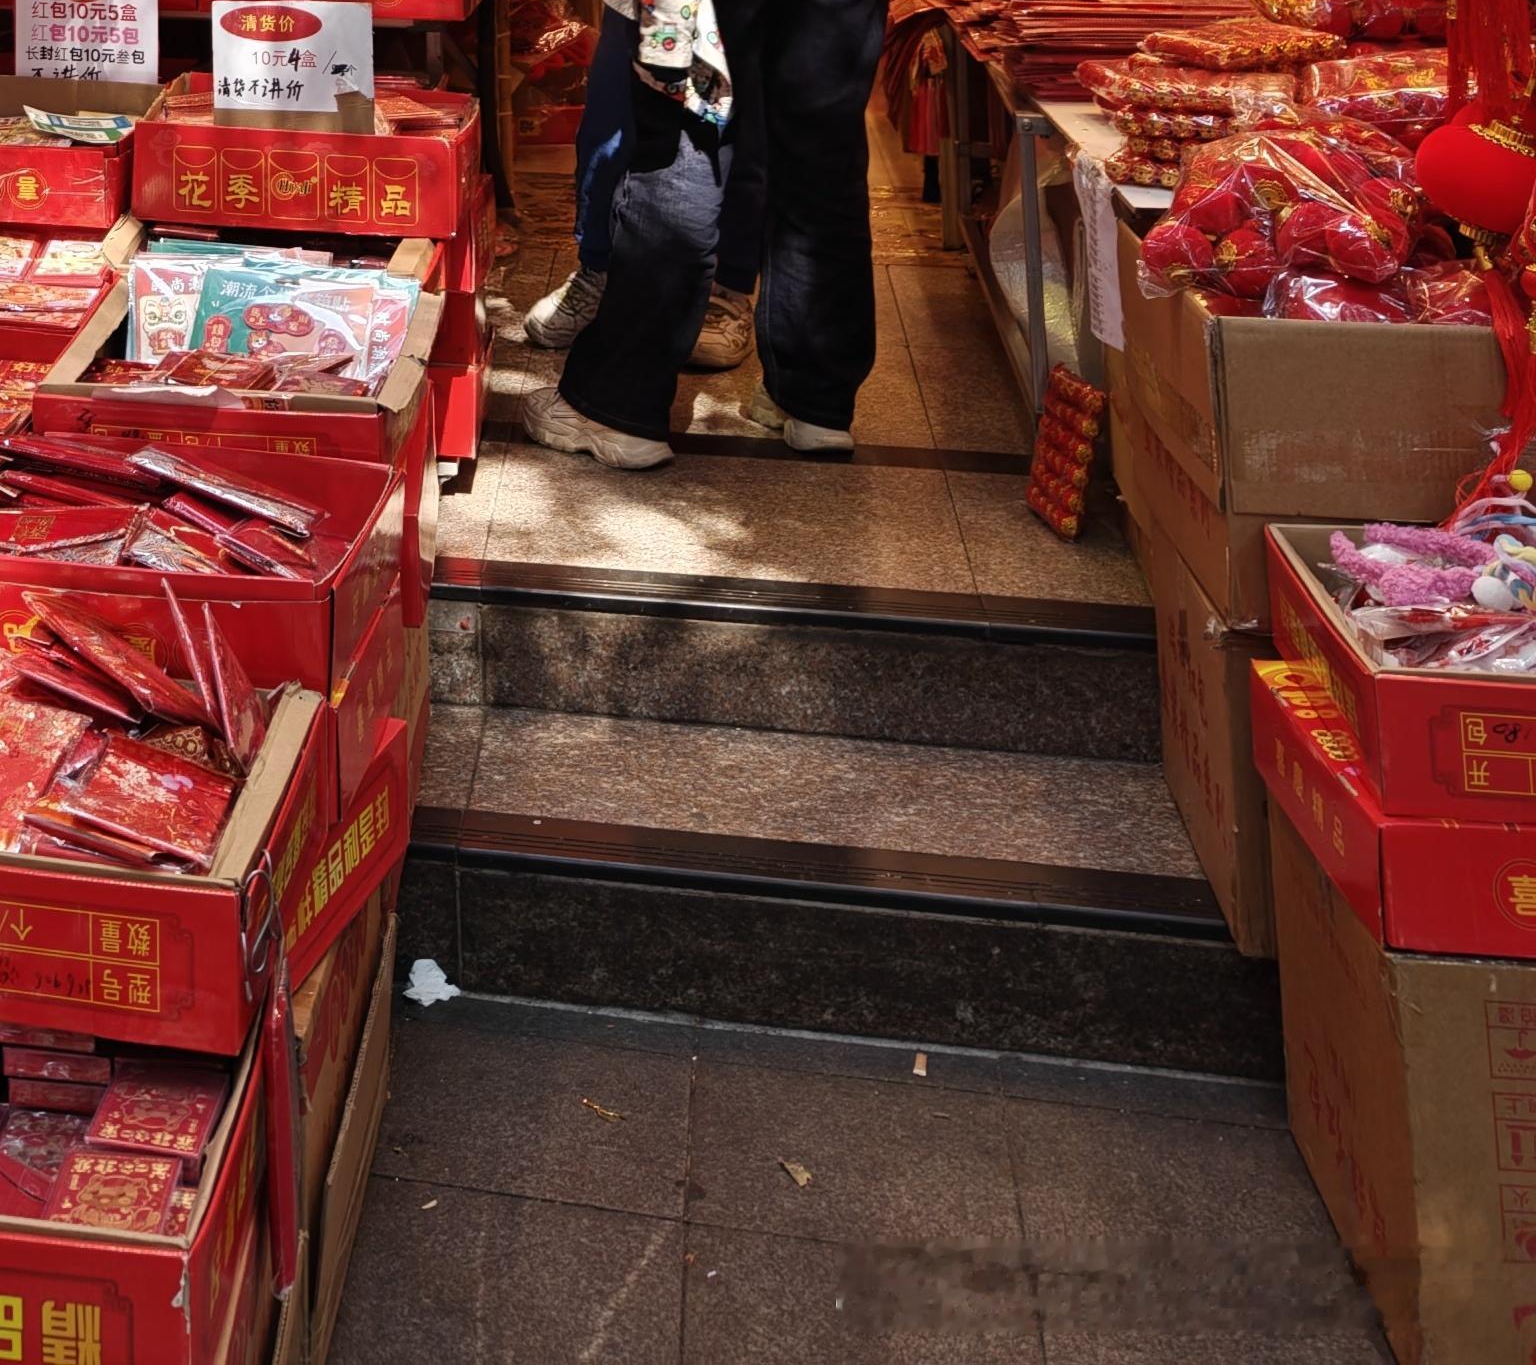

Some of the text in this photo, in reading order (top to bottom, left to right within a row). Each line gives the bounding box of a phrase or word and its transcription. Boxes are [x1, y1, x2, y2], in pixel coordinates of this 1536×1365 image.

[31, 0, 138, 23] 红包10元5盒
[239, 13, 296, 33] 清货价
[31, 23, 140, 45] 红包10元5包
[24, 45, 146, 65] 长封红包10元叁包
[251, 47, 318, 72] 10元4盒
[217, 75, 305, 102] 清货不讲价
[176, 168, 263, 211] 花季
[327, 178, 414, 218] 精品
[1465, 717, 1487, 747] 包
[1468, 759, 1491, 787] 开
[96, 916, 152, 957] 数量
[98, 966, 152, 1007] 型号
